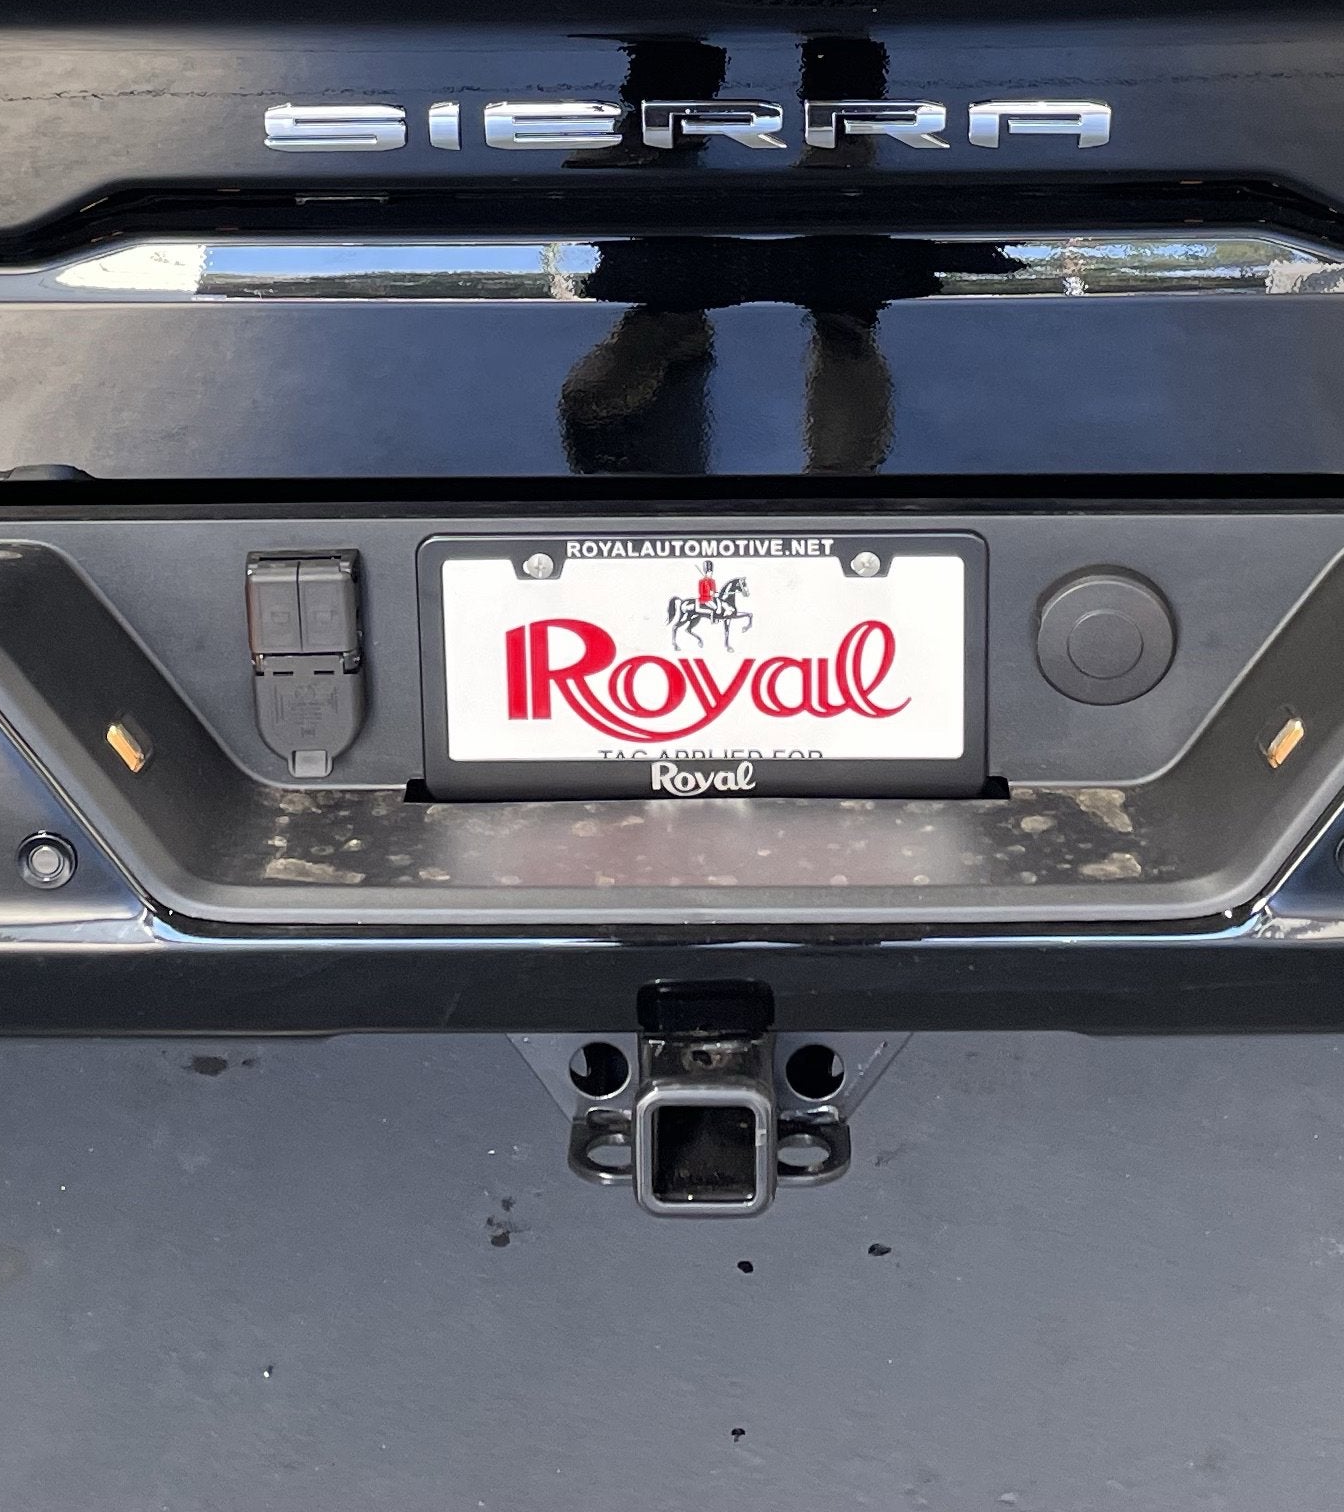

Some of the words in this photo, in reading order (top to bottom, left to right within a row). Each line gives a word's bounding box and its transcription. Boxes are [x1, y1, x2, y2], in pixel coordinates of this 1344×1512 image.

[263, 99, 1113, 152] SIERRA
[565, 538, 835, 558] ROYALAUTOMOTIVE.NET
[505, 618, 912, 743] Royal
[651, 760, 757, 797] Royal
